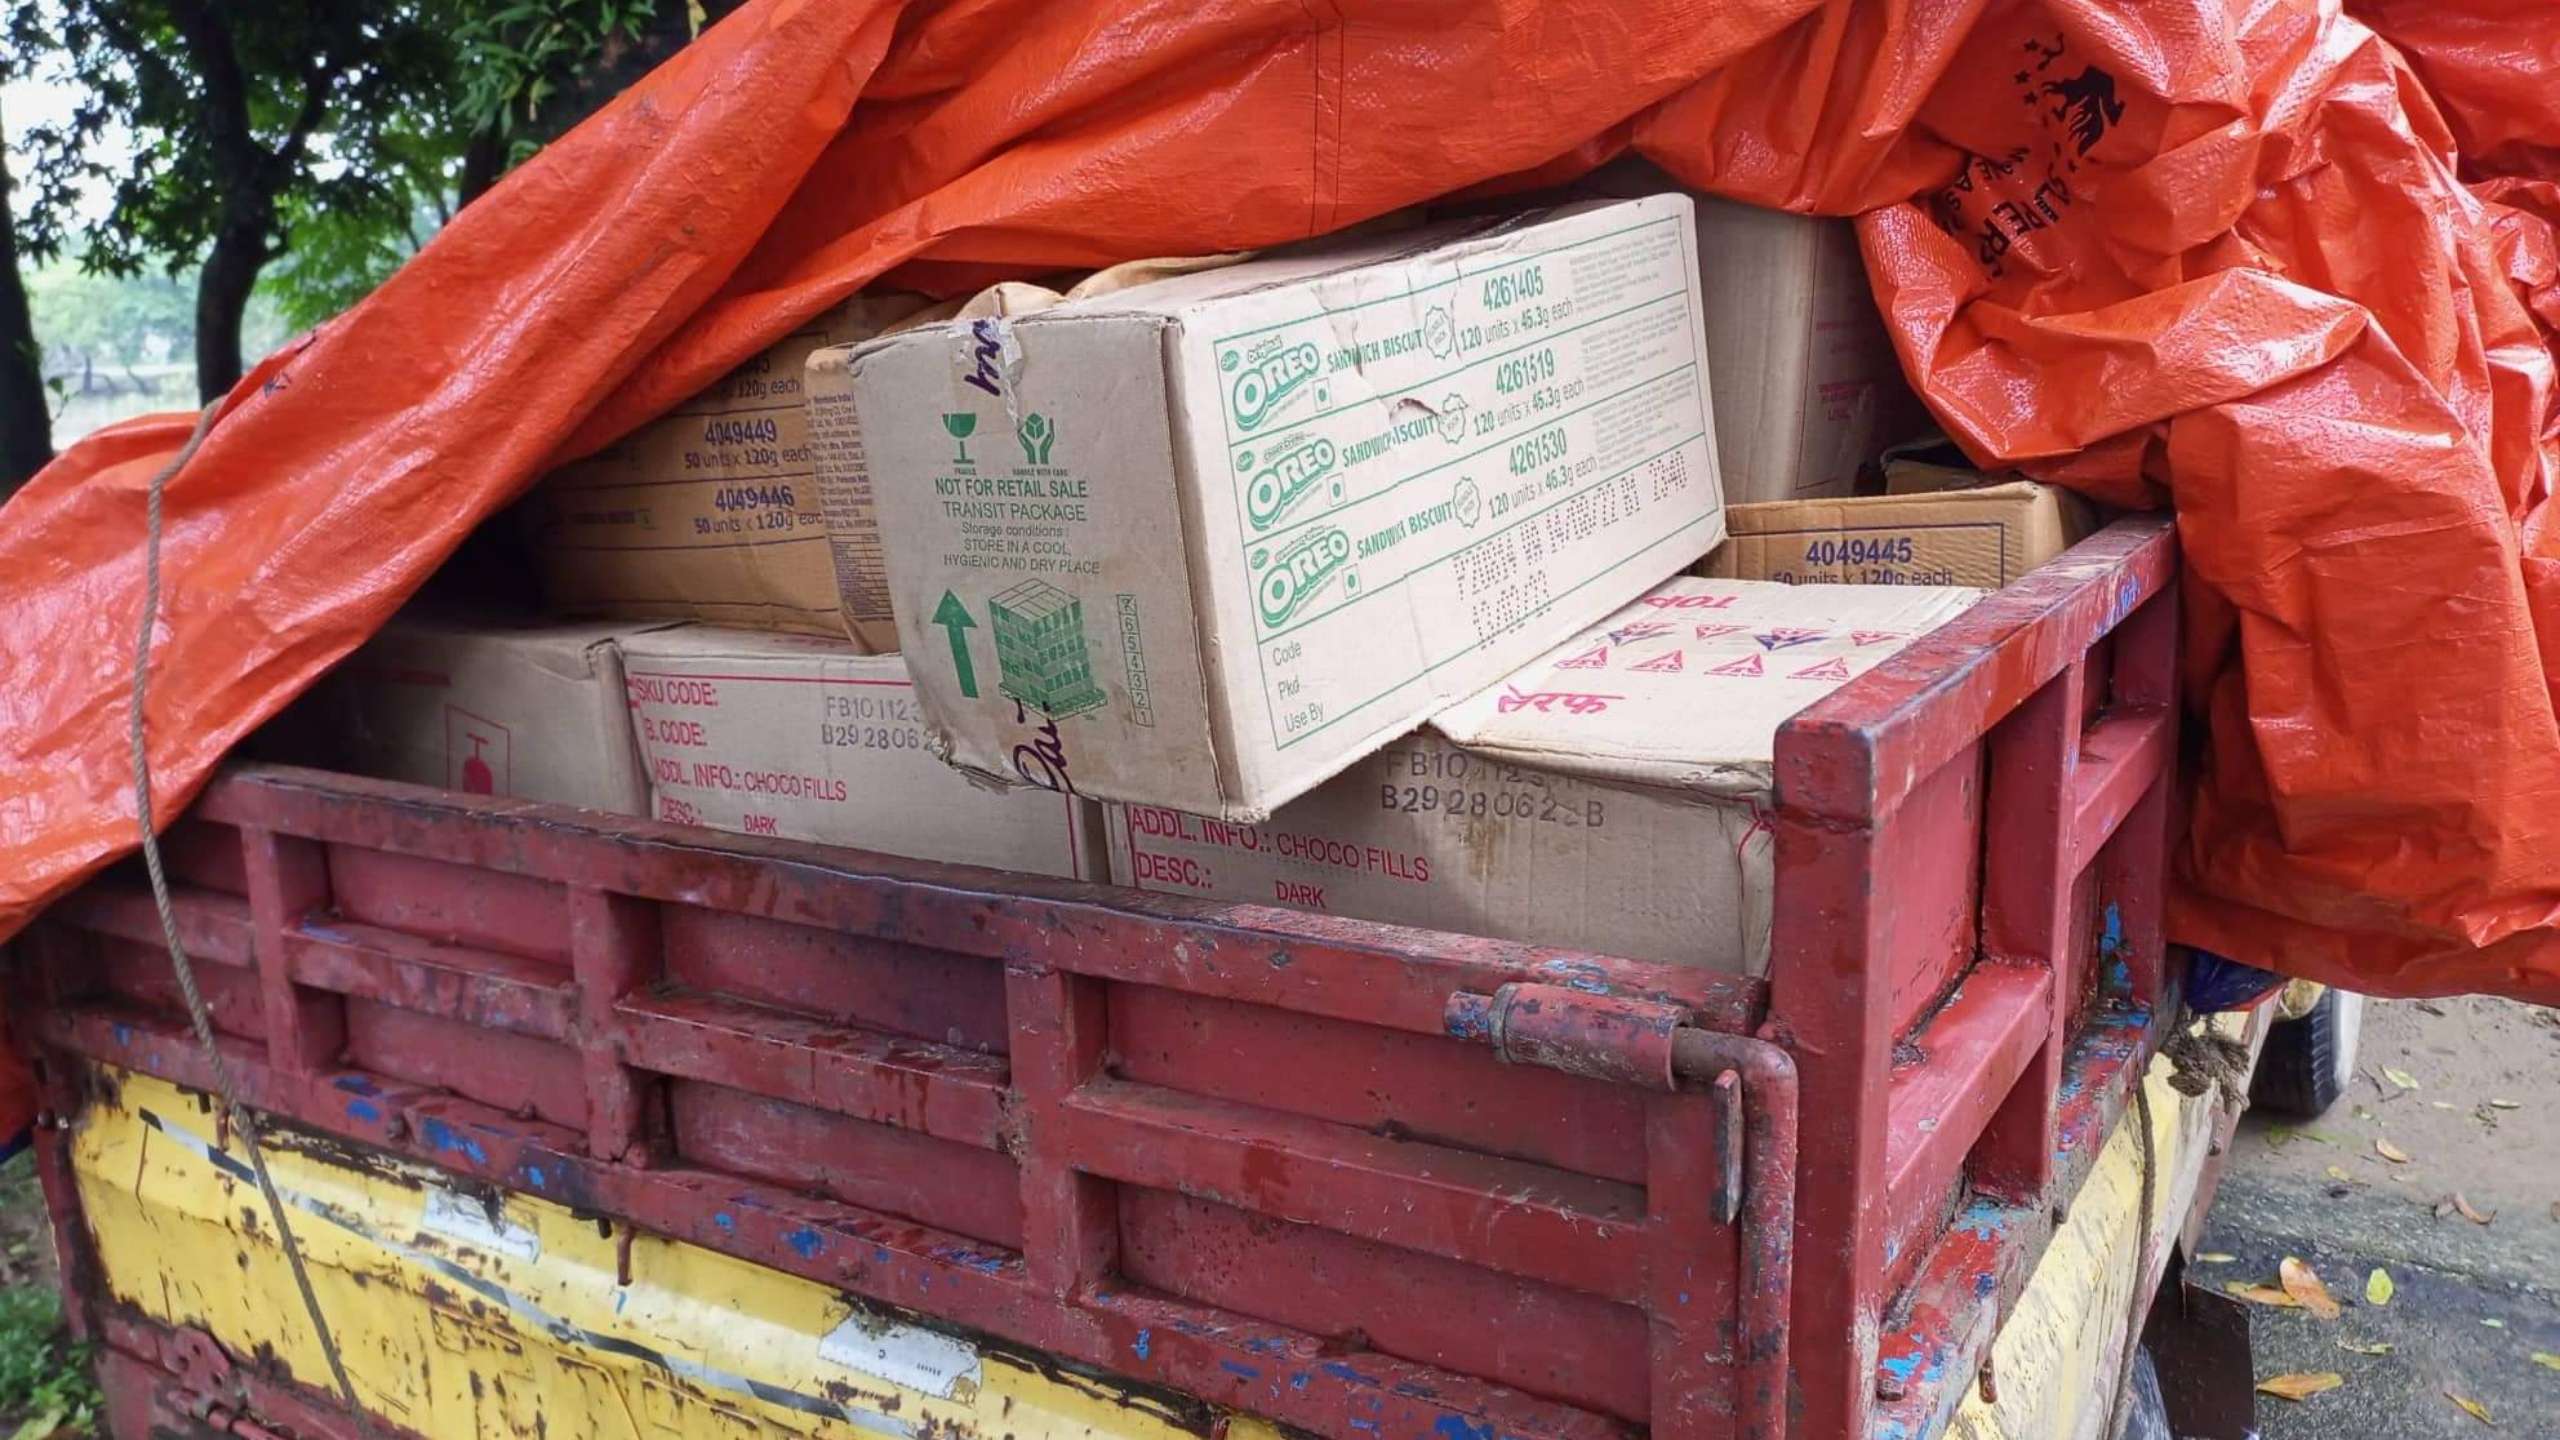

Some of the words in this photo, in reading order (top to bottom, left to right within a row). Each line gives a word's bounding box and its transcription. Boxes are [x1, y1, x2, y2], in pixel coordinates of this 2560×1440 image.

[1483, 265, 1544, 311] 4261405
[1460, 325, 1482, 351] 120
[1484, 320, 1511, 343] units
[1521, 306, 1549, 330] 45.3g
[1552, 297, 1574, 321] each
[1327, 343, 1381, 373] SANDWICH
[1383, 328, 1423, 357] BISCUIT
[1496, 348, 1555, 395] 4261519
[738, 379, 767, 399] 120g
[771, 377, 801, 394] each
[1232, 342, 1320, 431] OREO
[1474, 411, 1495, 437] 120
[1497, 403, 1522, 427] units
[1532, 386, 1560, 409] 45.3g
[1563, 377, 1585, 400] each
[705, 418, 778, 446] 4049449
[1391, 413, 1438, 450] ISCUIT
[684, 453, 701, 470] 50
[703, 453, 731, 467] units
[744, 448, 779, 467] 120g
[783, 444, 812, 463] each
[1509, 427, 1567, 477] 4261530
[715, 485, 795, 512] 4049446
[935, 477, 961, 496] NOT
[966, 478, 994, 496] FOR
[997, 479, 1046, 498] RETAIL
[1050, 480, 1089, 498] SALE
[1247, 438, 1335, 531] OREO
[1488, 492, 1509, 519] 120
[1511, 484, 1536, 509] units
[1575, 453, 1598, 479] each
[694, 519, 711, 535] 50
[712, 516, 740, 533] units
[757, 511, 794, 531] 120g
[799, 512, 823, 526] eac
[942, 501, 1005, 519] TRANSIT
[1010, 503, 1088, 521] PACKAGE
[1409, 500, 1453, 534] BISCUIT
[962, 521, 1002, 537] Storage
[964, 538, 1003, 552] STORE
[1007, 540, 1019, 553] IN
[1021, 541, 1029, 553] A
[1033, 541, 1072, 556] COOL,
[1806, 537, 1913, 566] 4049445
[943, 554, 999, 568] HYGIENIC
[1001, 556, 1027, 571] AND
[1030, 558, 1055, 571] DRY
[1059, 560, 1100, 574] PLACE
[1260, 529, 1349, 628] OREO
[1798, 571, 1839, 585] units
[1860, 569, 1906, 586] 120g
[1911, 568, 1953, 586] each
[1643, 594, 1737, 609] TOP
[1272, 640, 1302, 666] Code
[637, 679, 664, 703] SKU
[669, 681, 718, 706] CODE:
[1278, 674, 1300, 700] Pkd
[644, 717, 660, 742] B.
[660, 721, 708, 746] CODE:
[1284, 711, 1308, 732] Use
[1308, 702, 1324, 722] By
[745, 771, 801, 794] CHOCO
[804, 776, 847, 801] FILLS
[743, 814, 778, 836] DARK
[1130, 807, 1197, 841] ADDL.
[1277, 832, 1360, 868] CHOCO
[1366, 846, 1430, 882] FILLS
[1136, 852, 1213, 889] DESC.:
[1275, 880, 1326, 908] DARK
